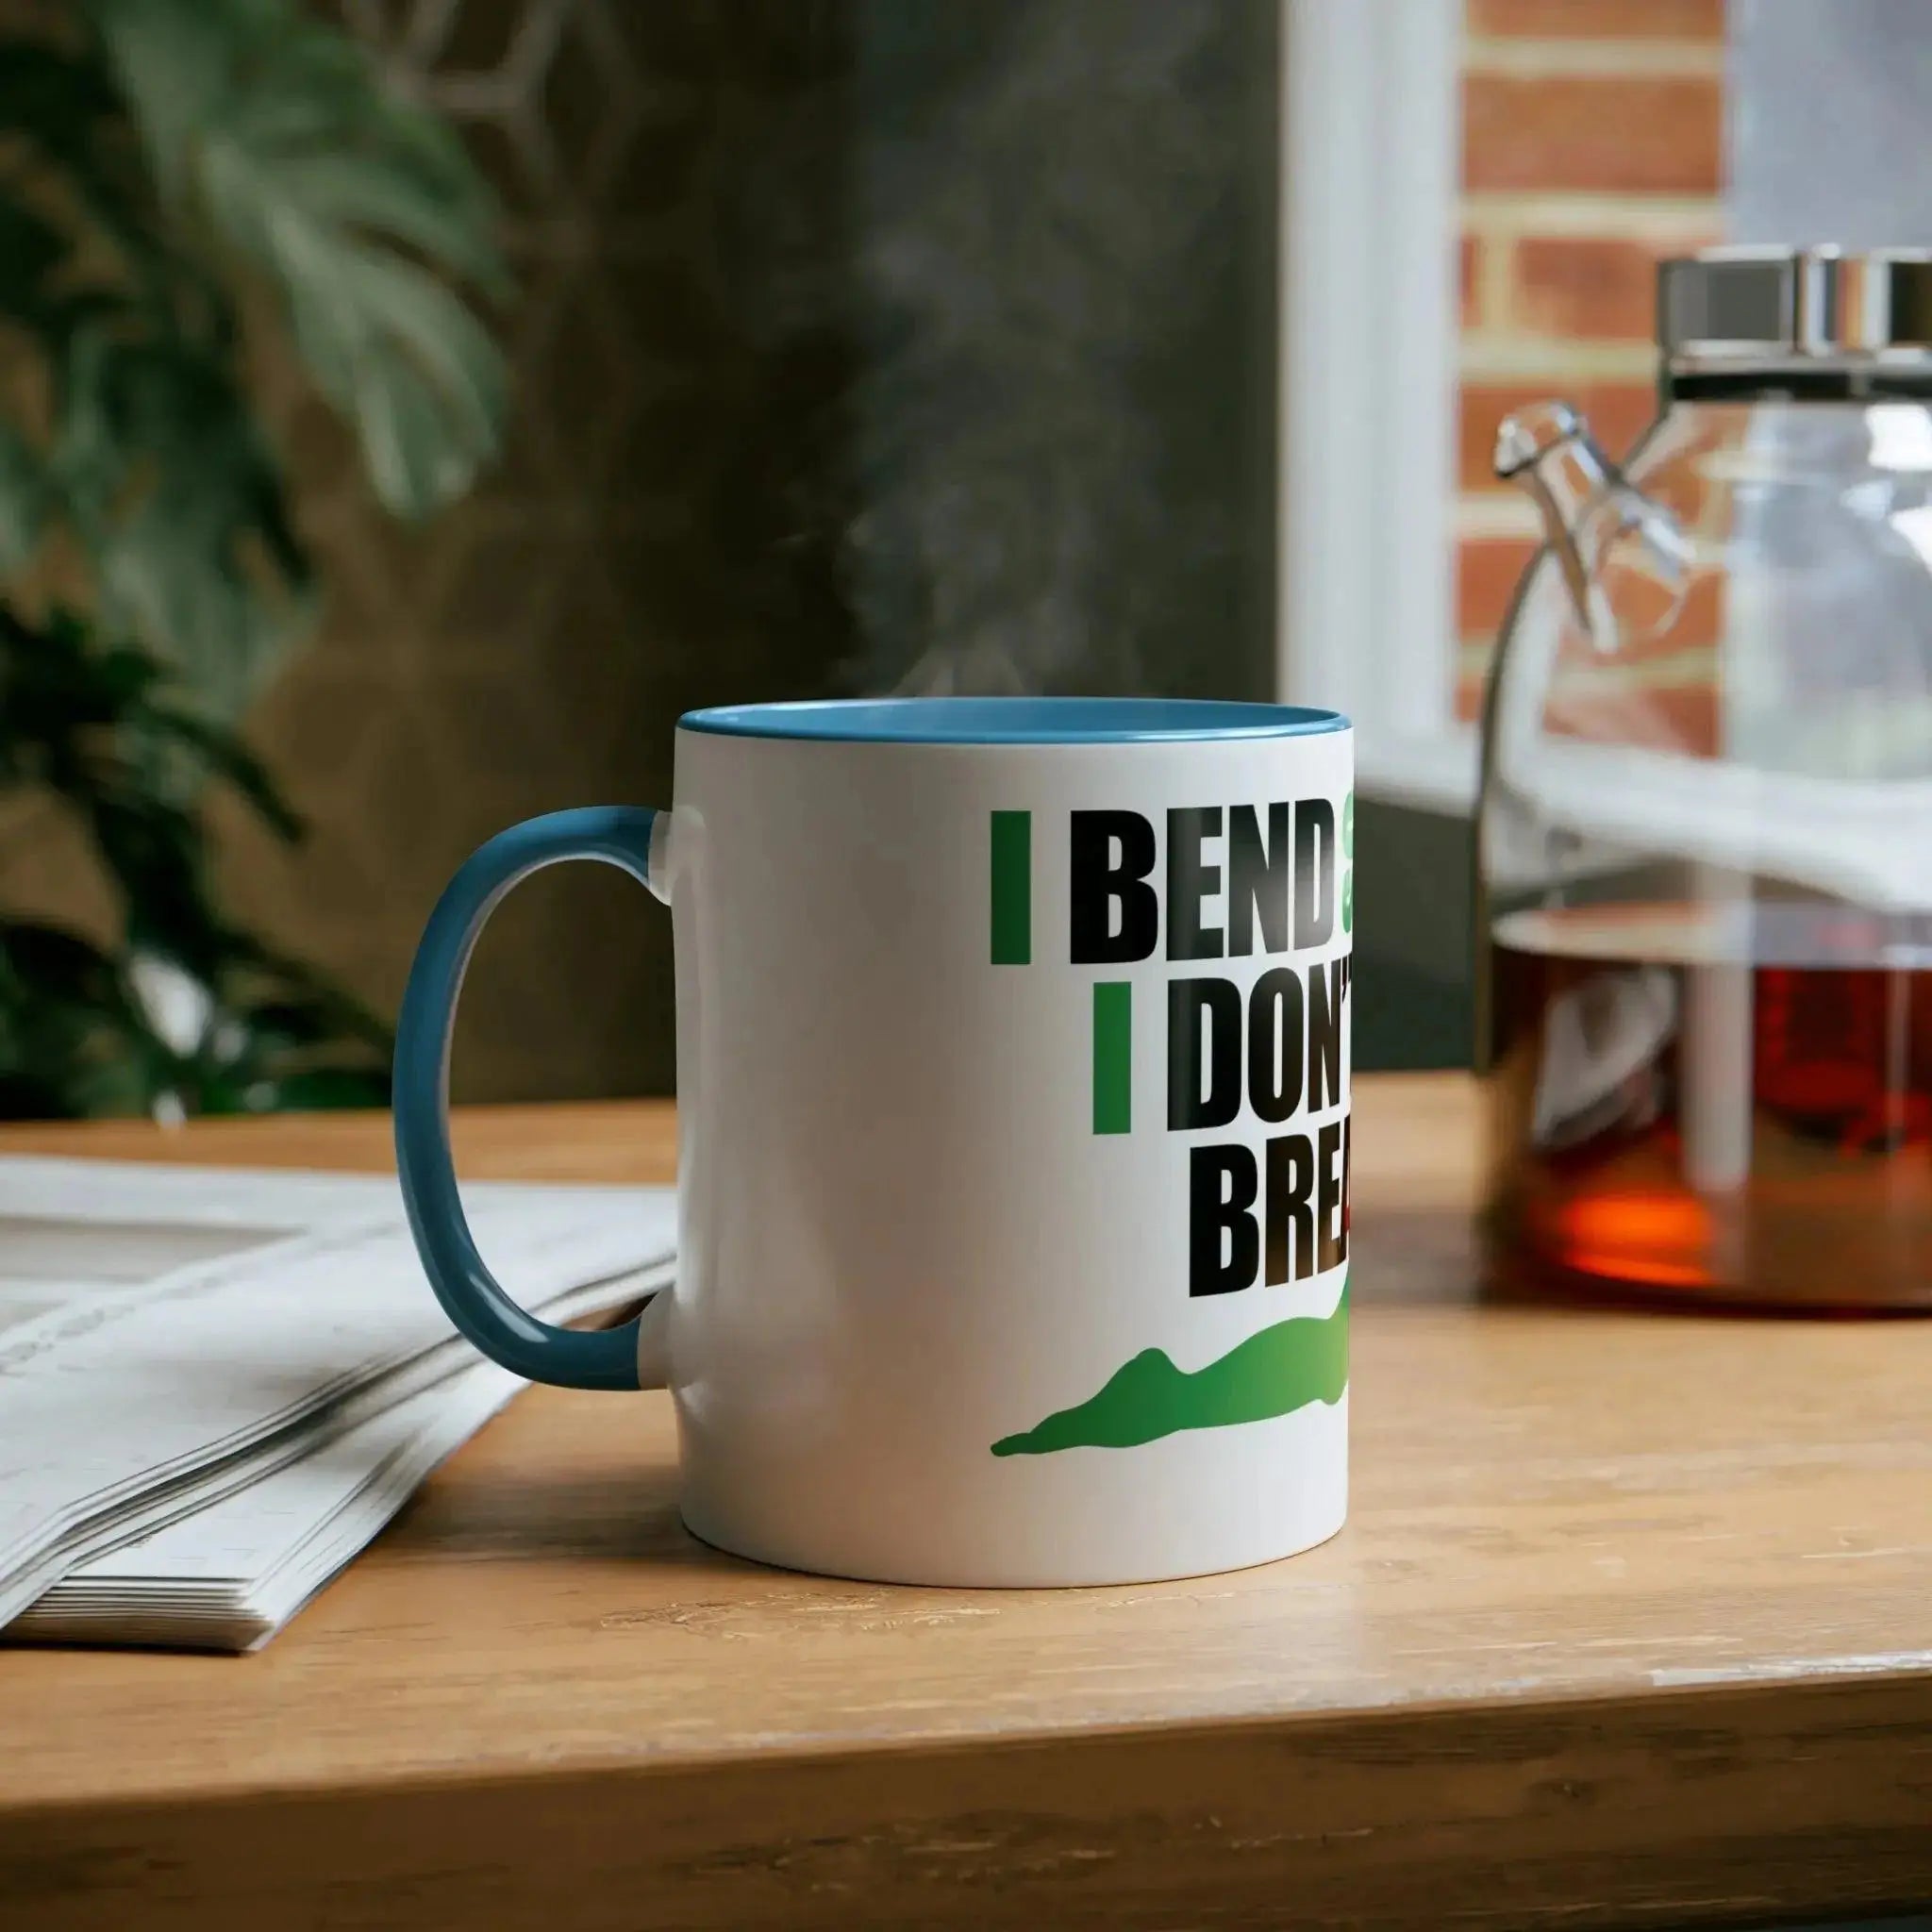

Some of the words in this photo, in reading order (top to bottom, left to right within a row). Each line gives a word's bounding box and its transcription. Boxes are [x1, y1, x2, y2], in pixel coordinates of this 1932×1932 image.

[991, 810, 1031, 965] I
[1070, 798, 1334, 964] BEND
[1093, 981, 1131, 1135] I
[1167, 953, 1352, 1132] DON'
